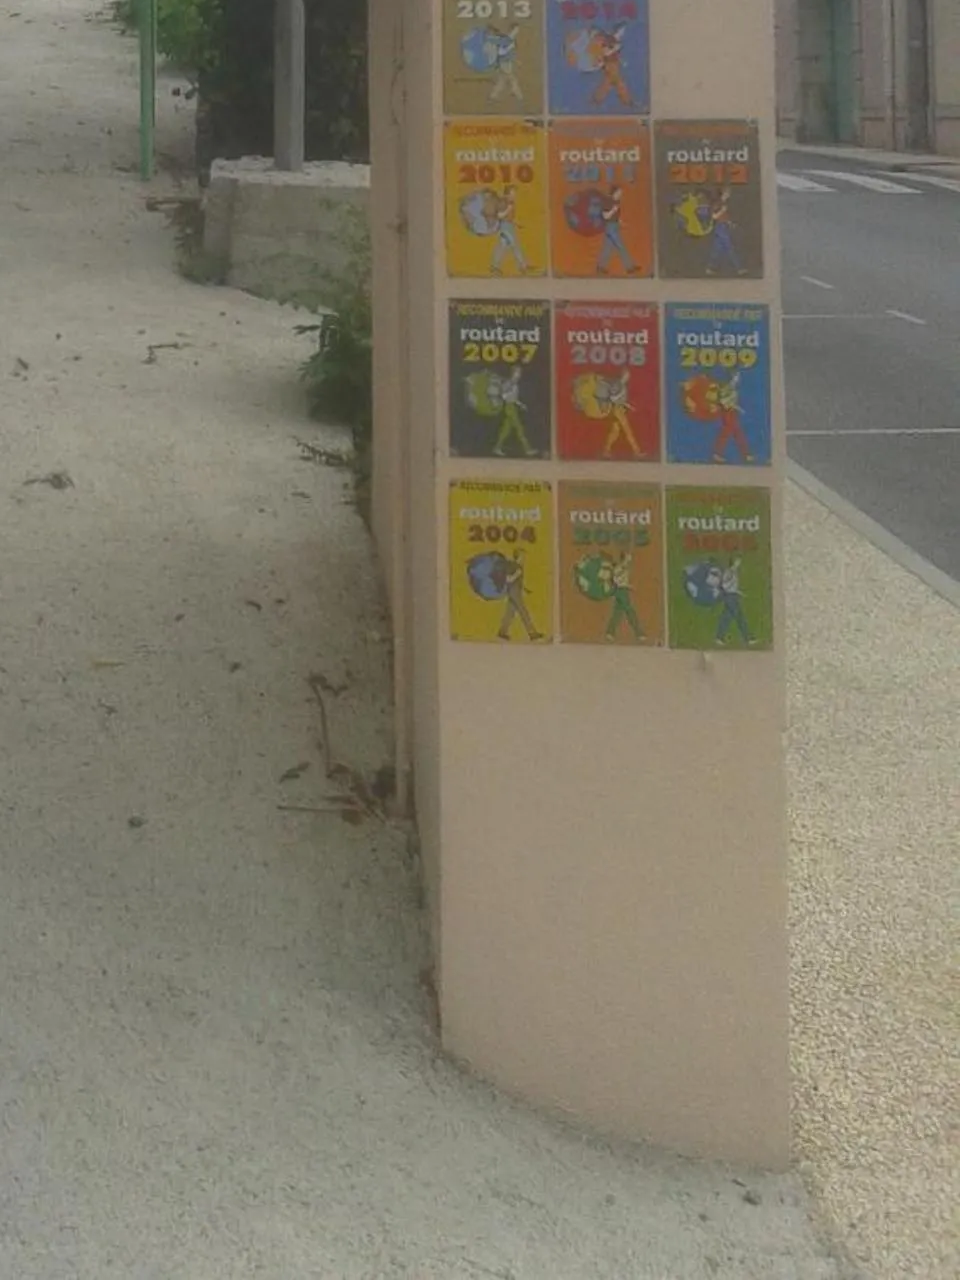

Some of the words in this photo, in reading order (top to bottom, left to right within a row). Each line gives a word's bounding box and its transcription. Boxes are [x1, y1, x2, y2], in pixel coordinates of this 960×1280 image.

[457, 0, 533, 19] 2013
[456, 146, 535, 162] routard
[560, 145, 640, 162] routard
[667, 146, 749, 163] routard
[458, 163, 535, 184] 2010
[460, 326, 541, 343] routard
[567, 328, 649, 345] routard
[677, 330, 760, 348] routard
[463, 342, 538, 363] 2007
[571, 345, 646, 366] 2008
[460, 505, 543, 522] routard
[569, 508, 652, 525] routard
[678, 514, 760, 532] routard
[467, 524, 537, 545] 2004
